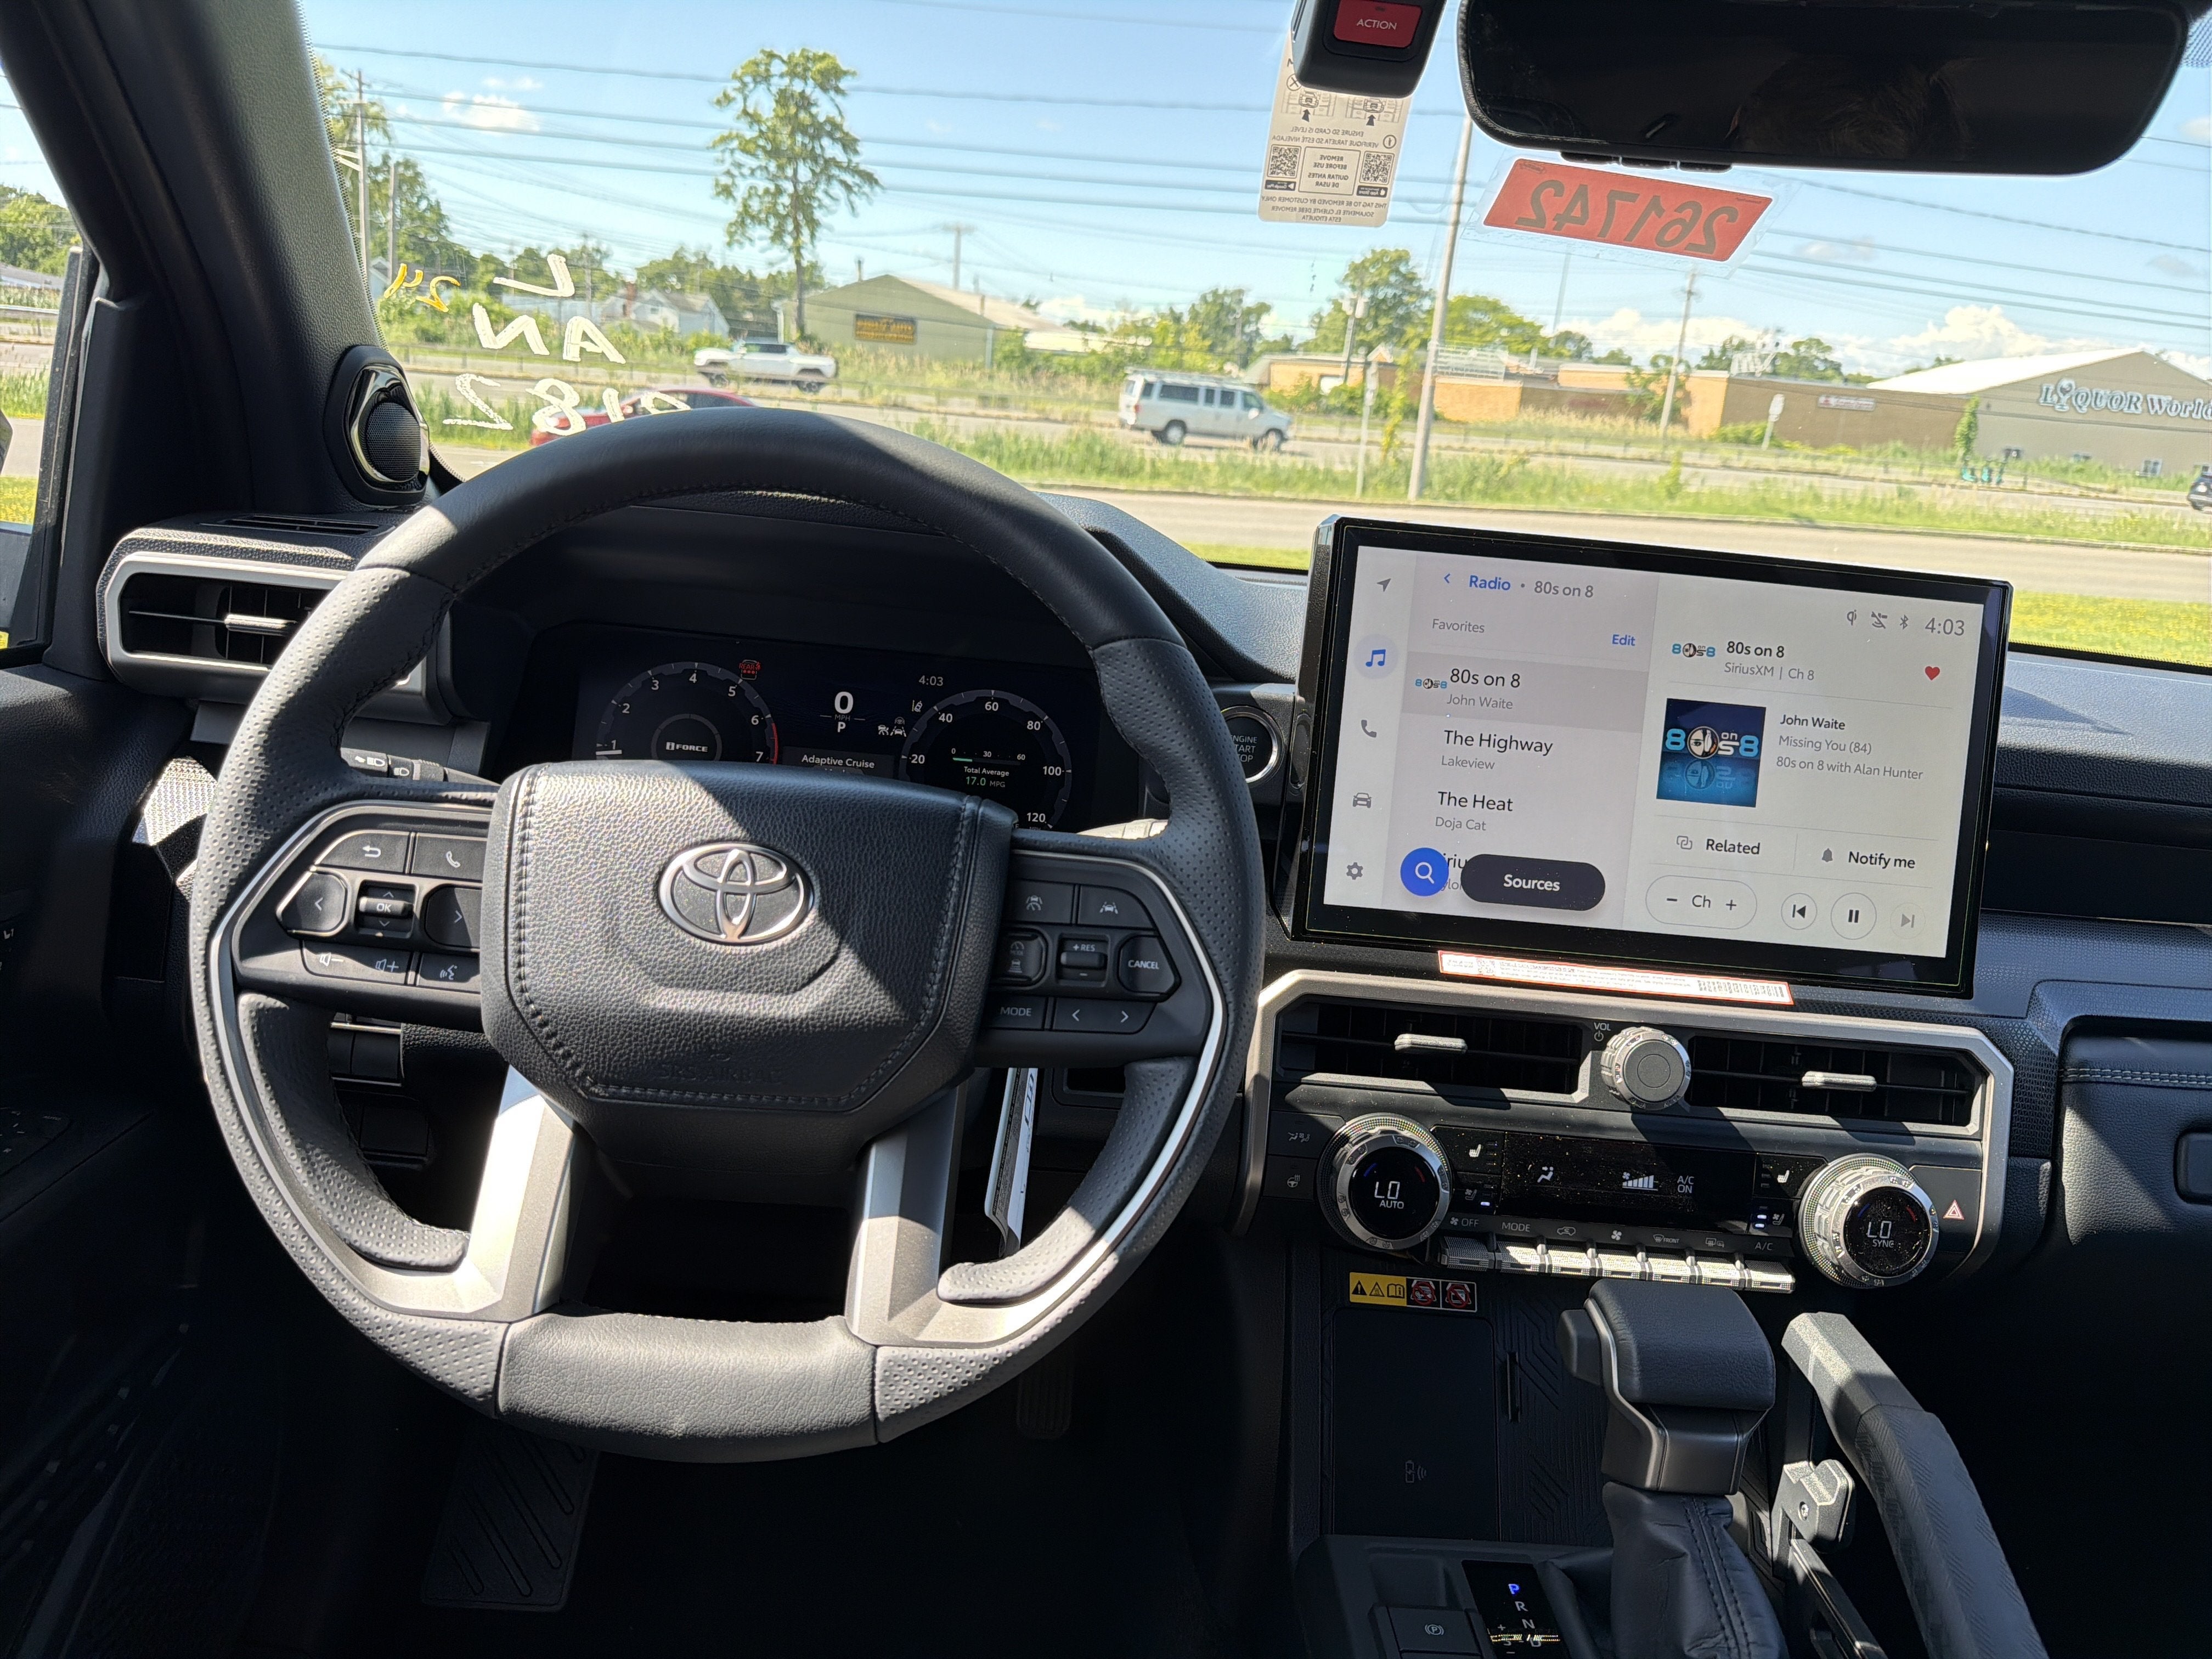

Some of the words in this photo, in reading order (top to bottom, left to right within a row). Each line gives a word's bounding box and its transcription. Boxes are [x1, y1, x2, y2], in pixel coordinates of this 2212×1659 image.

[1356, 18, 1397, 31] ACTION
[1469, 574, 1511, 591] Radio
[1534, 580, 1559, 596] 80s
[1562, 585, 1581, 597] on
[1584, 584, 1594, 598] 8
[1431, 618, 1485, 634] Favorites
[1925, 617, 1965, 637] 4:03
[1612, 634, 1635, 647] Edit
[1727, 641, 1751, 657] 80s
[1754, 645, 1773, 657] on
[1776, 645, 1785, 658] 8
[1724, 662, 1775, 677] SiriusXM
[1788, 667, 1804, 680] Ch
[1807, 669, 1815, 681] 8
[689, 673, 697, 684] 4
[919, 675, 944, 687] 4:03
[1449, 668, 1479, 685] 80s
[1483, 674, 1505, 687] on
[1510, 673, 1521, 688] 8
[651, 680, 659, 691] 3
[728, 686, 736, 697] 5
[834, 691, 854, 714] 0
[985, 701, 999, 712] 60
[1447, 694, 1476, 708] John
[1479, 696, 1513, 710] Waite
[622, 703, 630, 714] 2
[751, 715, 759, 725] 6
[834, 714, 851, 722] MPH
[939, 713, 953, 724] 40
[1780, 714, 1809, 727] John
[1811, 716, 1846, 730] Waite
[837, 722, 846, 733] P
[1026, 720, 1041, 731] 80
[611, 740, 617, 750] 1
[1234, 744, 1256, 753] TART
[1444, 730, 1474, 747] The
[1479, 733, 1554, 757] Highway
[1779, 735, 1822, 752] Missing
[1825, 740, 1847, 752] You
[1849, 741, 1872, 755] (84)
[756, 752, 764, 762] 7
[802, 754, 843, 766] Adaptive
[845, 758, 875, 768] Cruise
[911, 754, 925, 765] 20
[1441, 755, 1495, 770] Lakeview
[964, 766, 980, 775] Total
[981, 768, 1009, 778] Average
[1042, 765, 1062, 776] 100
[1776, 756, 1796, 768] 80s
[1798, 759, 1814, 769] on
[1817, 759, 1824, 770] 8
[1826, 760, 1851, 774] with
[1854, 763, 1881, 776] Alan
[1883, 766, 1924, 780] Hunter
[966, 776, 986, 787] 17.0
[1437, 791, 1468, 808] The
[1472, 794, 1514, 811] Heat
[1027, 812, 1046, 822] 120
[1435, 816, 1463, 831] Doja
[1465, 819, 1487, 831] Cat
[1706, 838, 1760, 855] Related
[1848, 851, 1891, 870] Notify
[1893, 856, 1916, 869] me
[1503, 874, 1561, 891] Sources
[1692, 894, 1711, 909] Ch
[377, 903, 392, 912] OK
[1128, 960, 1159, 969] CANCEL
[1000, 1006, 1032, 1017] MODE
[1594, 1022, 1611, 1031] VOL
[1677, 1175, 1695, 1185] A/C
[1678, 1184, 1693, 1194] ON
[1379, 1200, 1404, 1209] AUTO
[1462, 1218, 1480, 1228] OFF
[1502, 1222, 1531, 1233] MODE
[1755, 1242, 1774, 1252] A/C
[1872, 1239, 1894, 1248] SYNC
[1508, 1583, 1520, 1595] P
[1515, 1601, 1528, 1612] R
[1522, 1619, 1536, 1629] N
